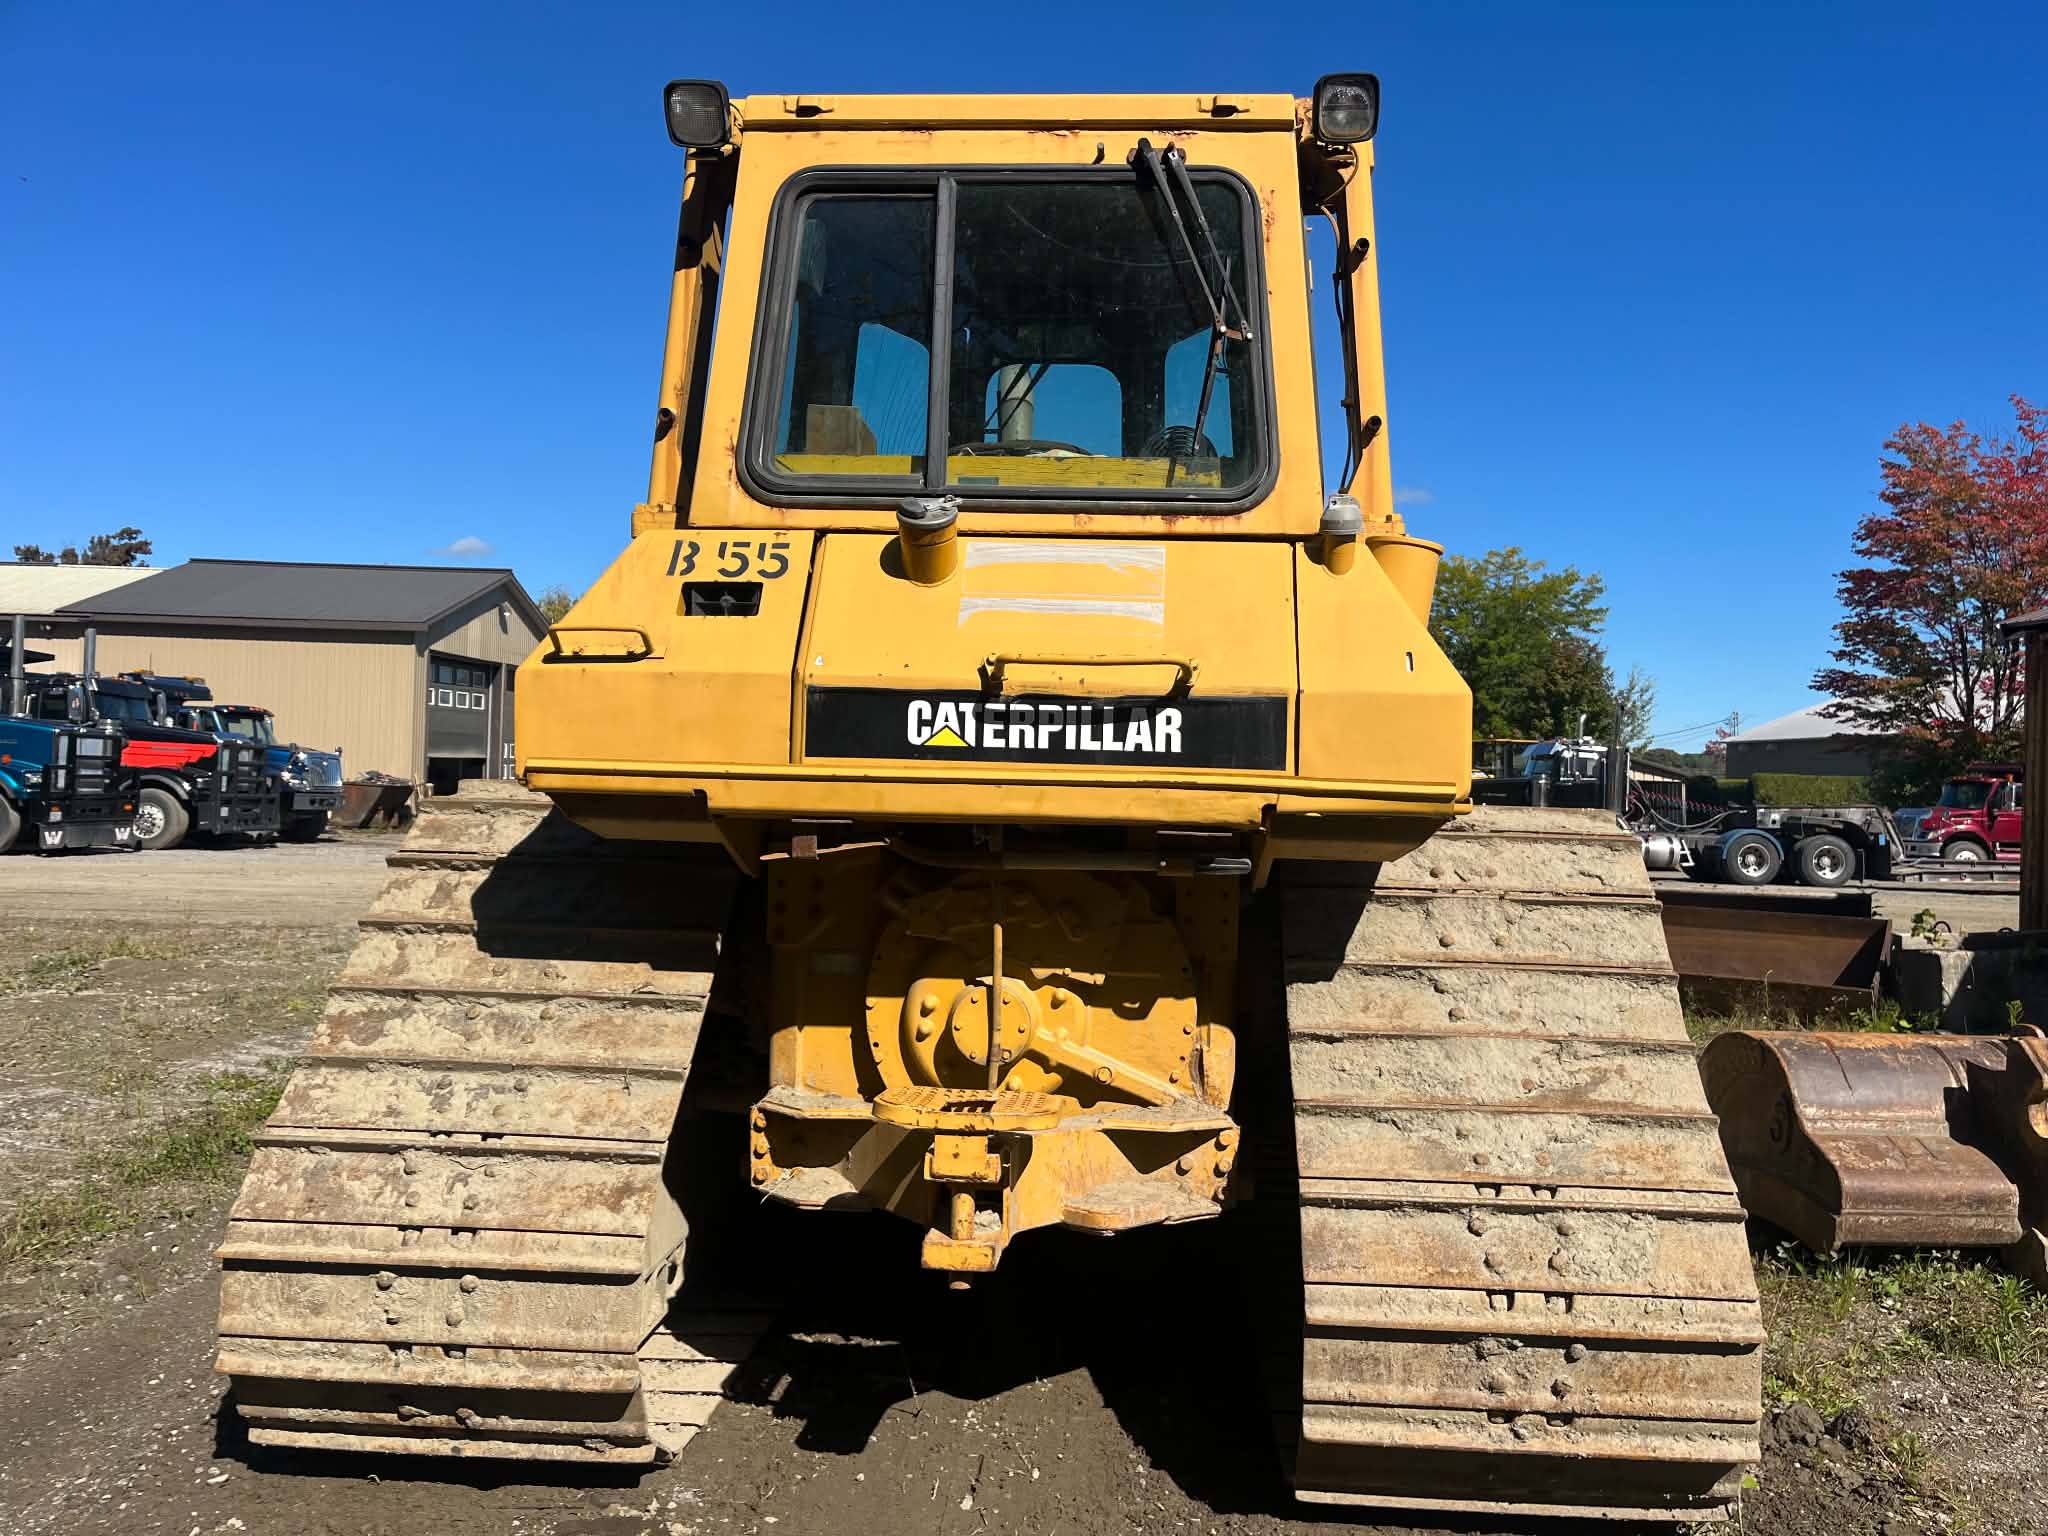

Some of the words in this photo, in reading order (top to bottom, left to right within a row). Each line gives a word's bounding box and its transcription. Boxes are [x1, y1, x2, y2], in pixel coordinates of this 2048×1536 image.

[666, 540, 700, 576] B
[718, 541, 790, 579] 55
[907, 699, 1182, 752] CATERPILLAR
